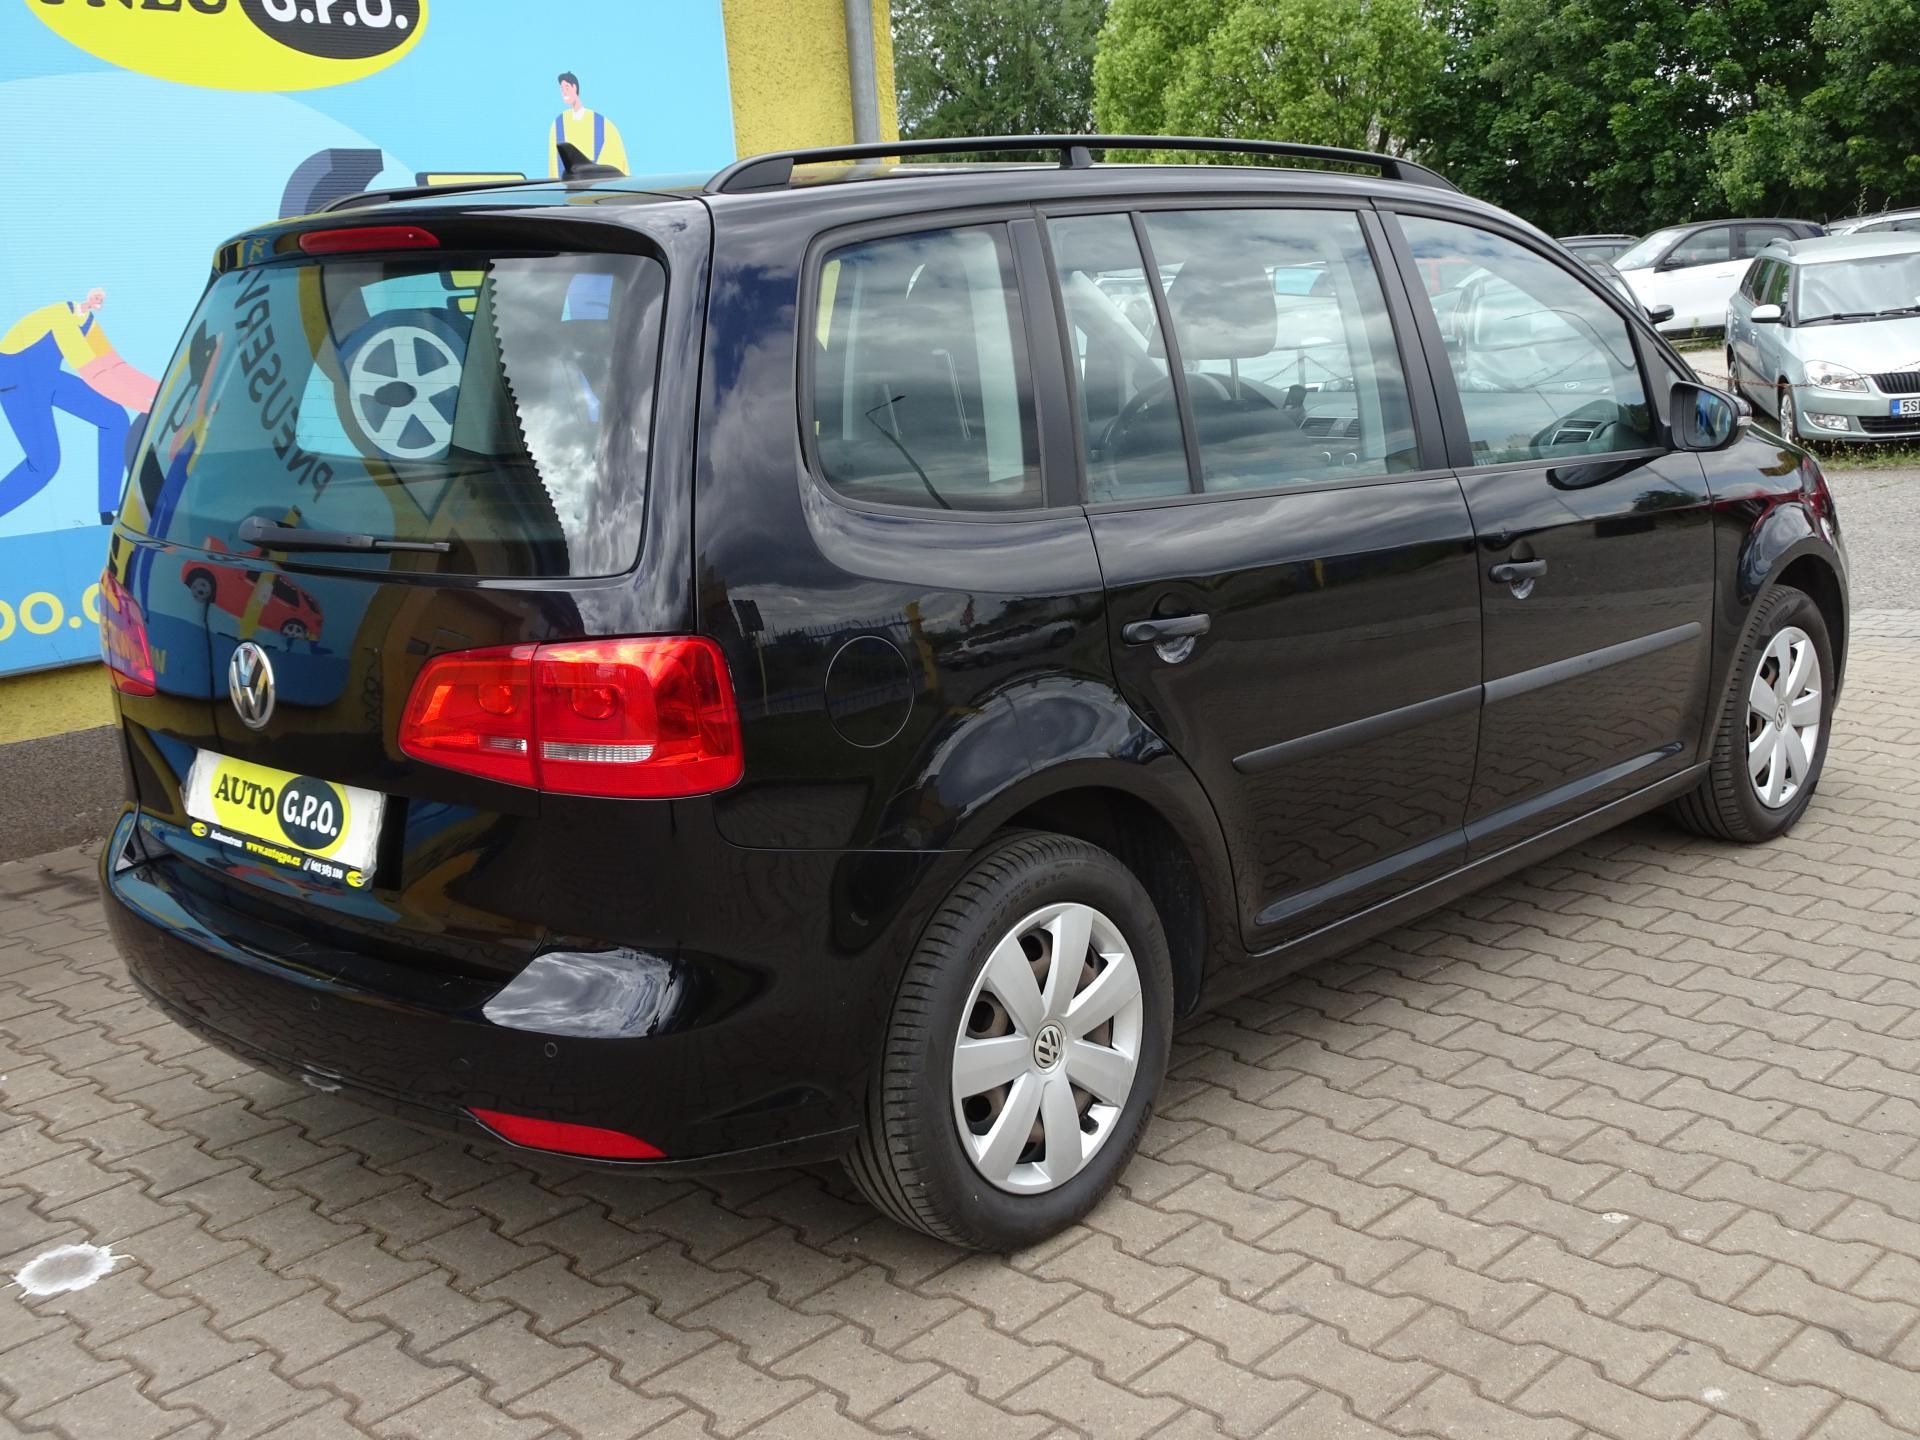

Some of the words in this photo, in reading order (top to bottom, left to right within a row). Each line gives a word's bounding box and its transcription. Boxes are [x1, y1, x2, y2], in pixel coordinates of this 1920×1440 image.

[1903, 400, 1920, 412] 5S
[215, 773, 275, 815] AUTO
[283, 790, 337, 836] G.P.O.
